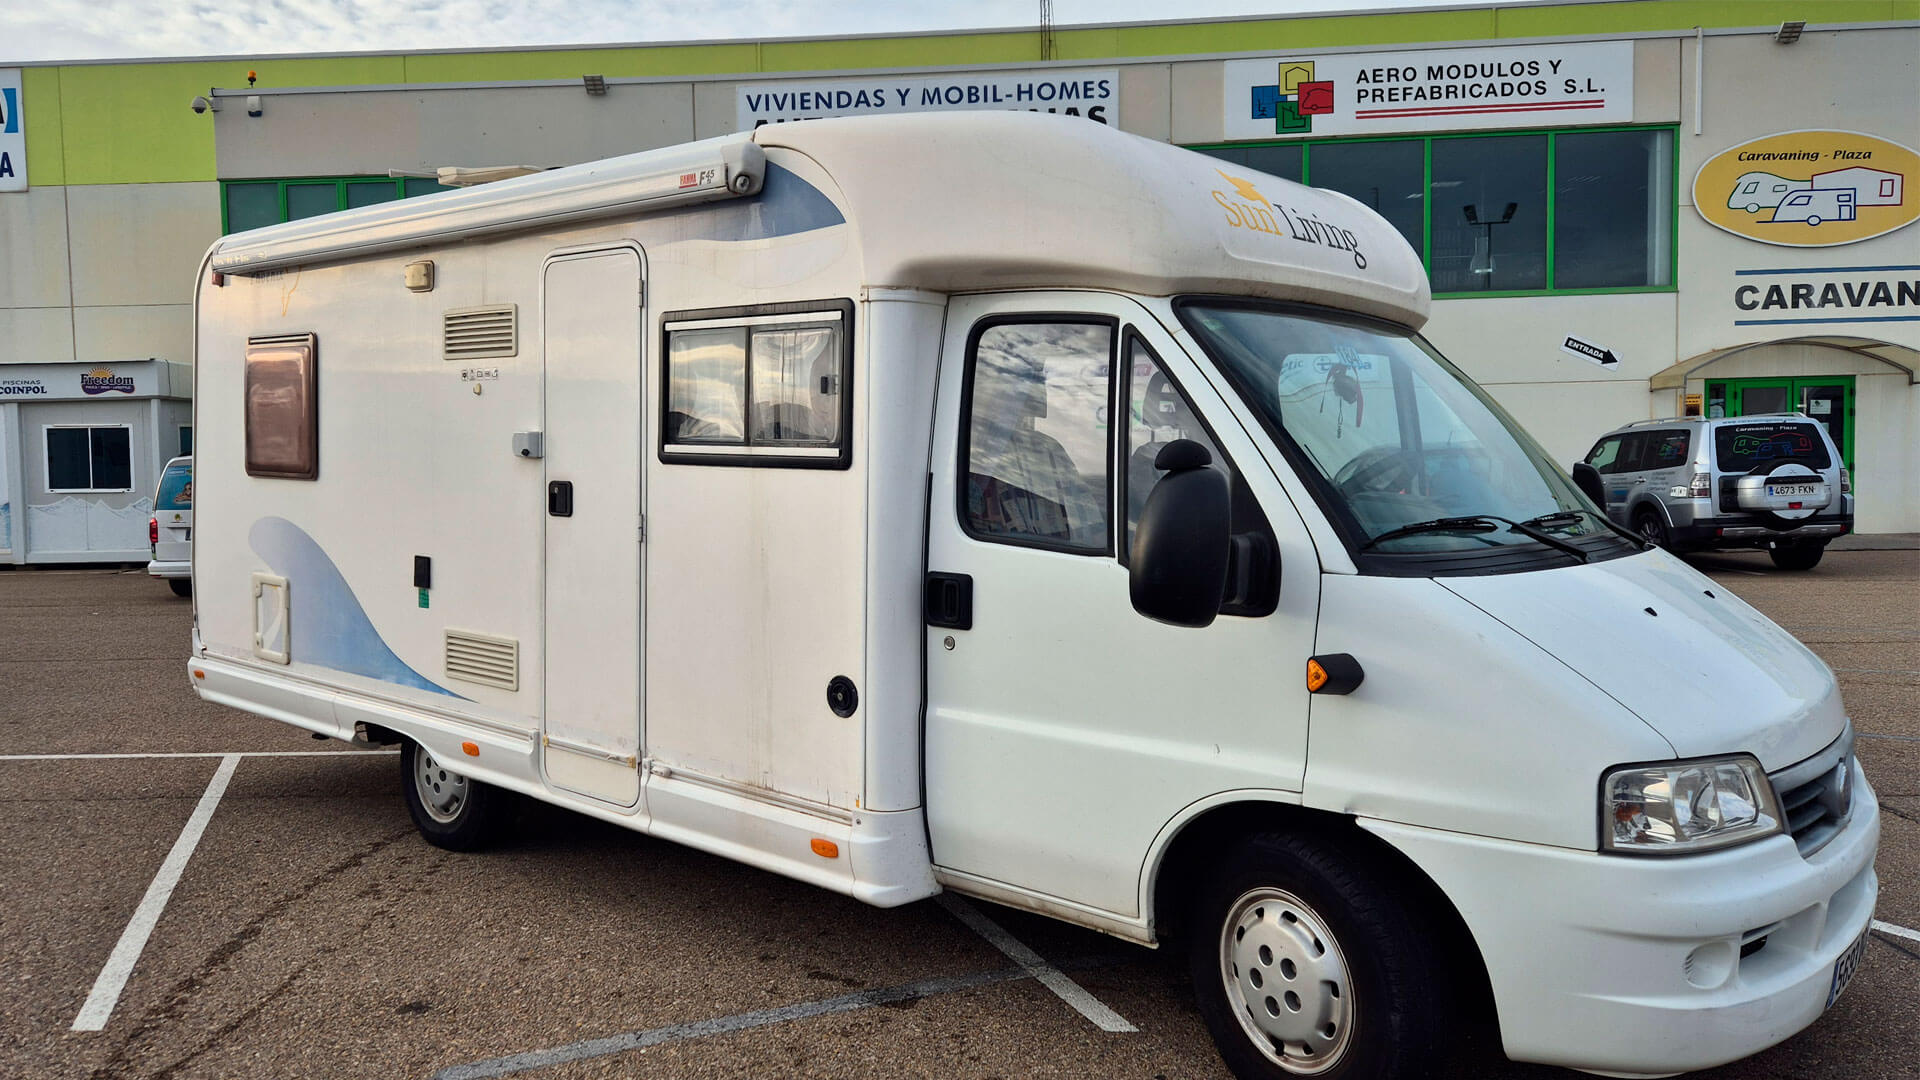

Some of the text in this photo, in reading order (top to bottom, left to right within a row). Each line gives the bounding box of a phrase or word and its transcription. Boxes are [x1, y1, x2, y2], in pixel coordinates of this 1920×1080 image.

[1356, 59, 1562, 84] AERO MODULOS Y
[746, 79, 1111, 112] VIVIENDAS Y MOBIL-HOMES
[1356, 77, 1605, 104] PREFABRICADOS S.L.
[1738, 150, 1820, 162] Caravaning
[1832, 149, 1873, 160] Plaza
[1211, 190, 1368, 270] Sun Living
[1568, 340, 1604, 359] ENTRADA
[80, 373, 134, 385] Freedom
